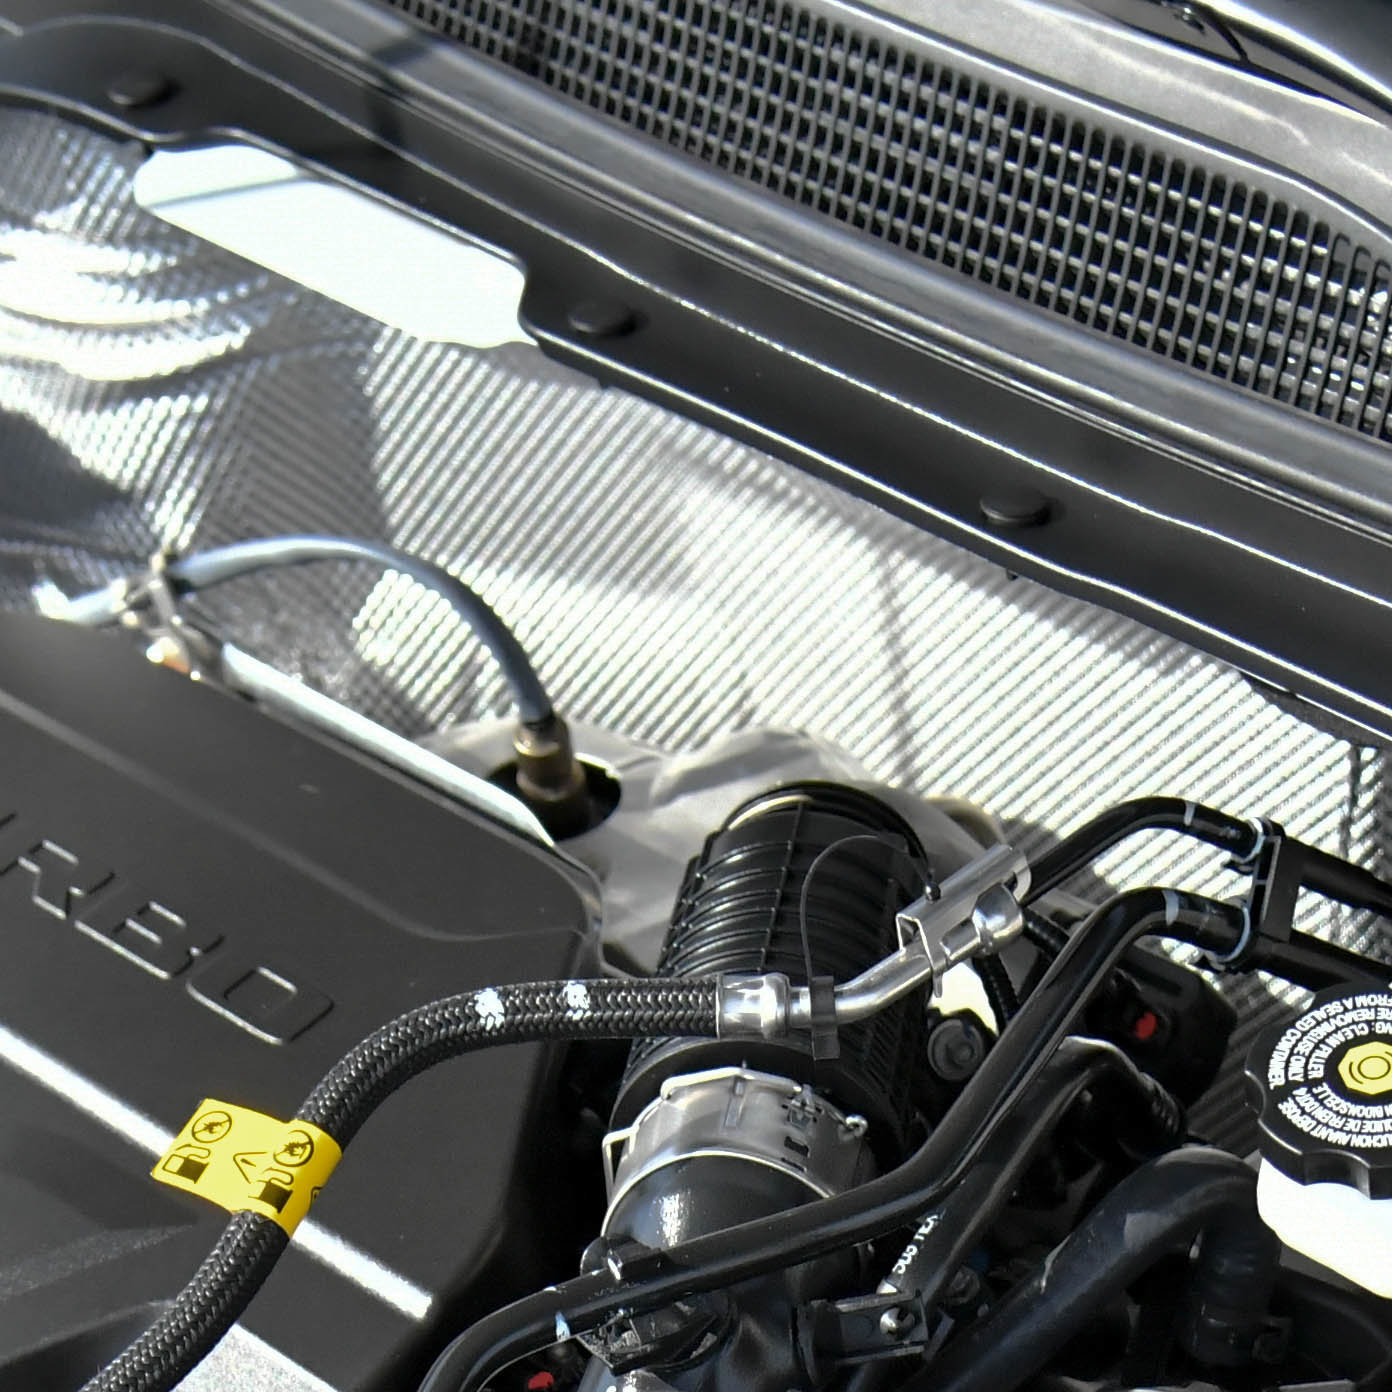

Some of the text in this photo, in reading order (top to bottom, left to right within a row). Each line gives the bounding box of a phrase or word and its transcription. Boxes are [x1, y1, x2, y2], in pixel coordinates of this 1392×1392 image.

[1295, 1001, 1344, 1031] SEALED
[1342, 997, 1353, 1010] A
[1325, 1022, 1369, 1048] CLEAN
[1288, 1055, 1306, 1081] ONLY
[1340, 1118, 1362, 1135] DE
